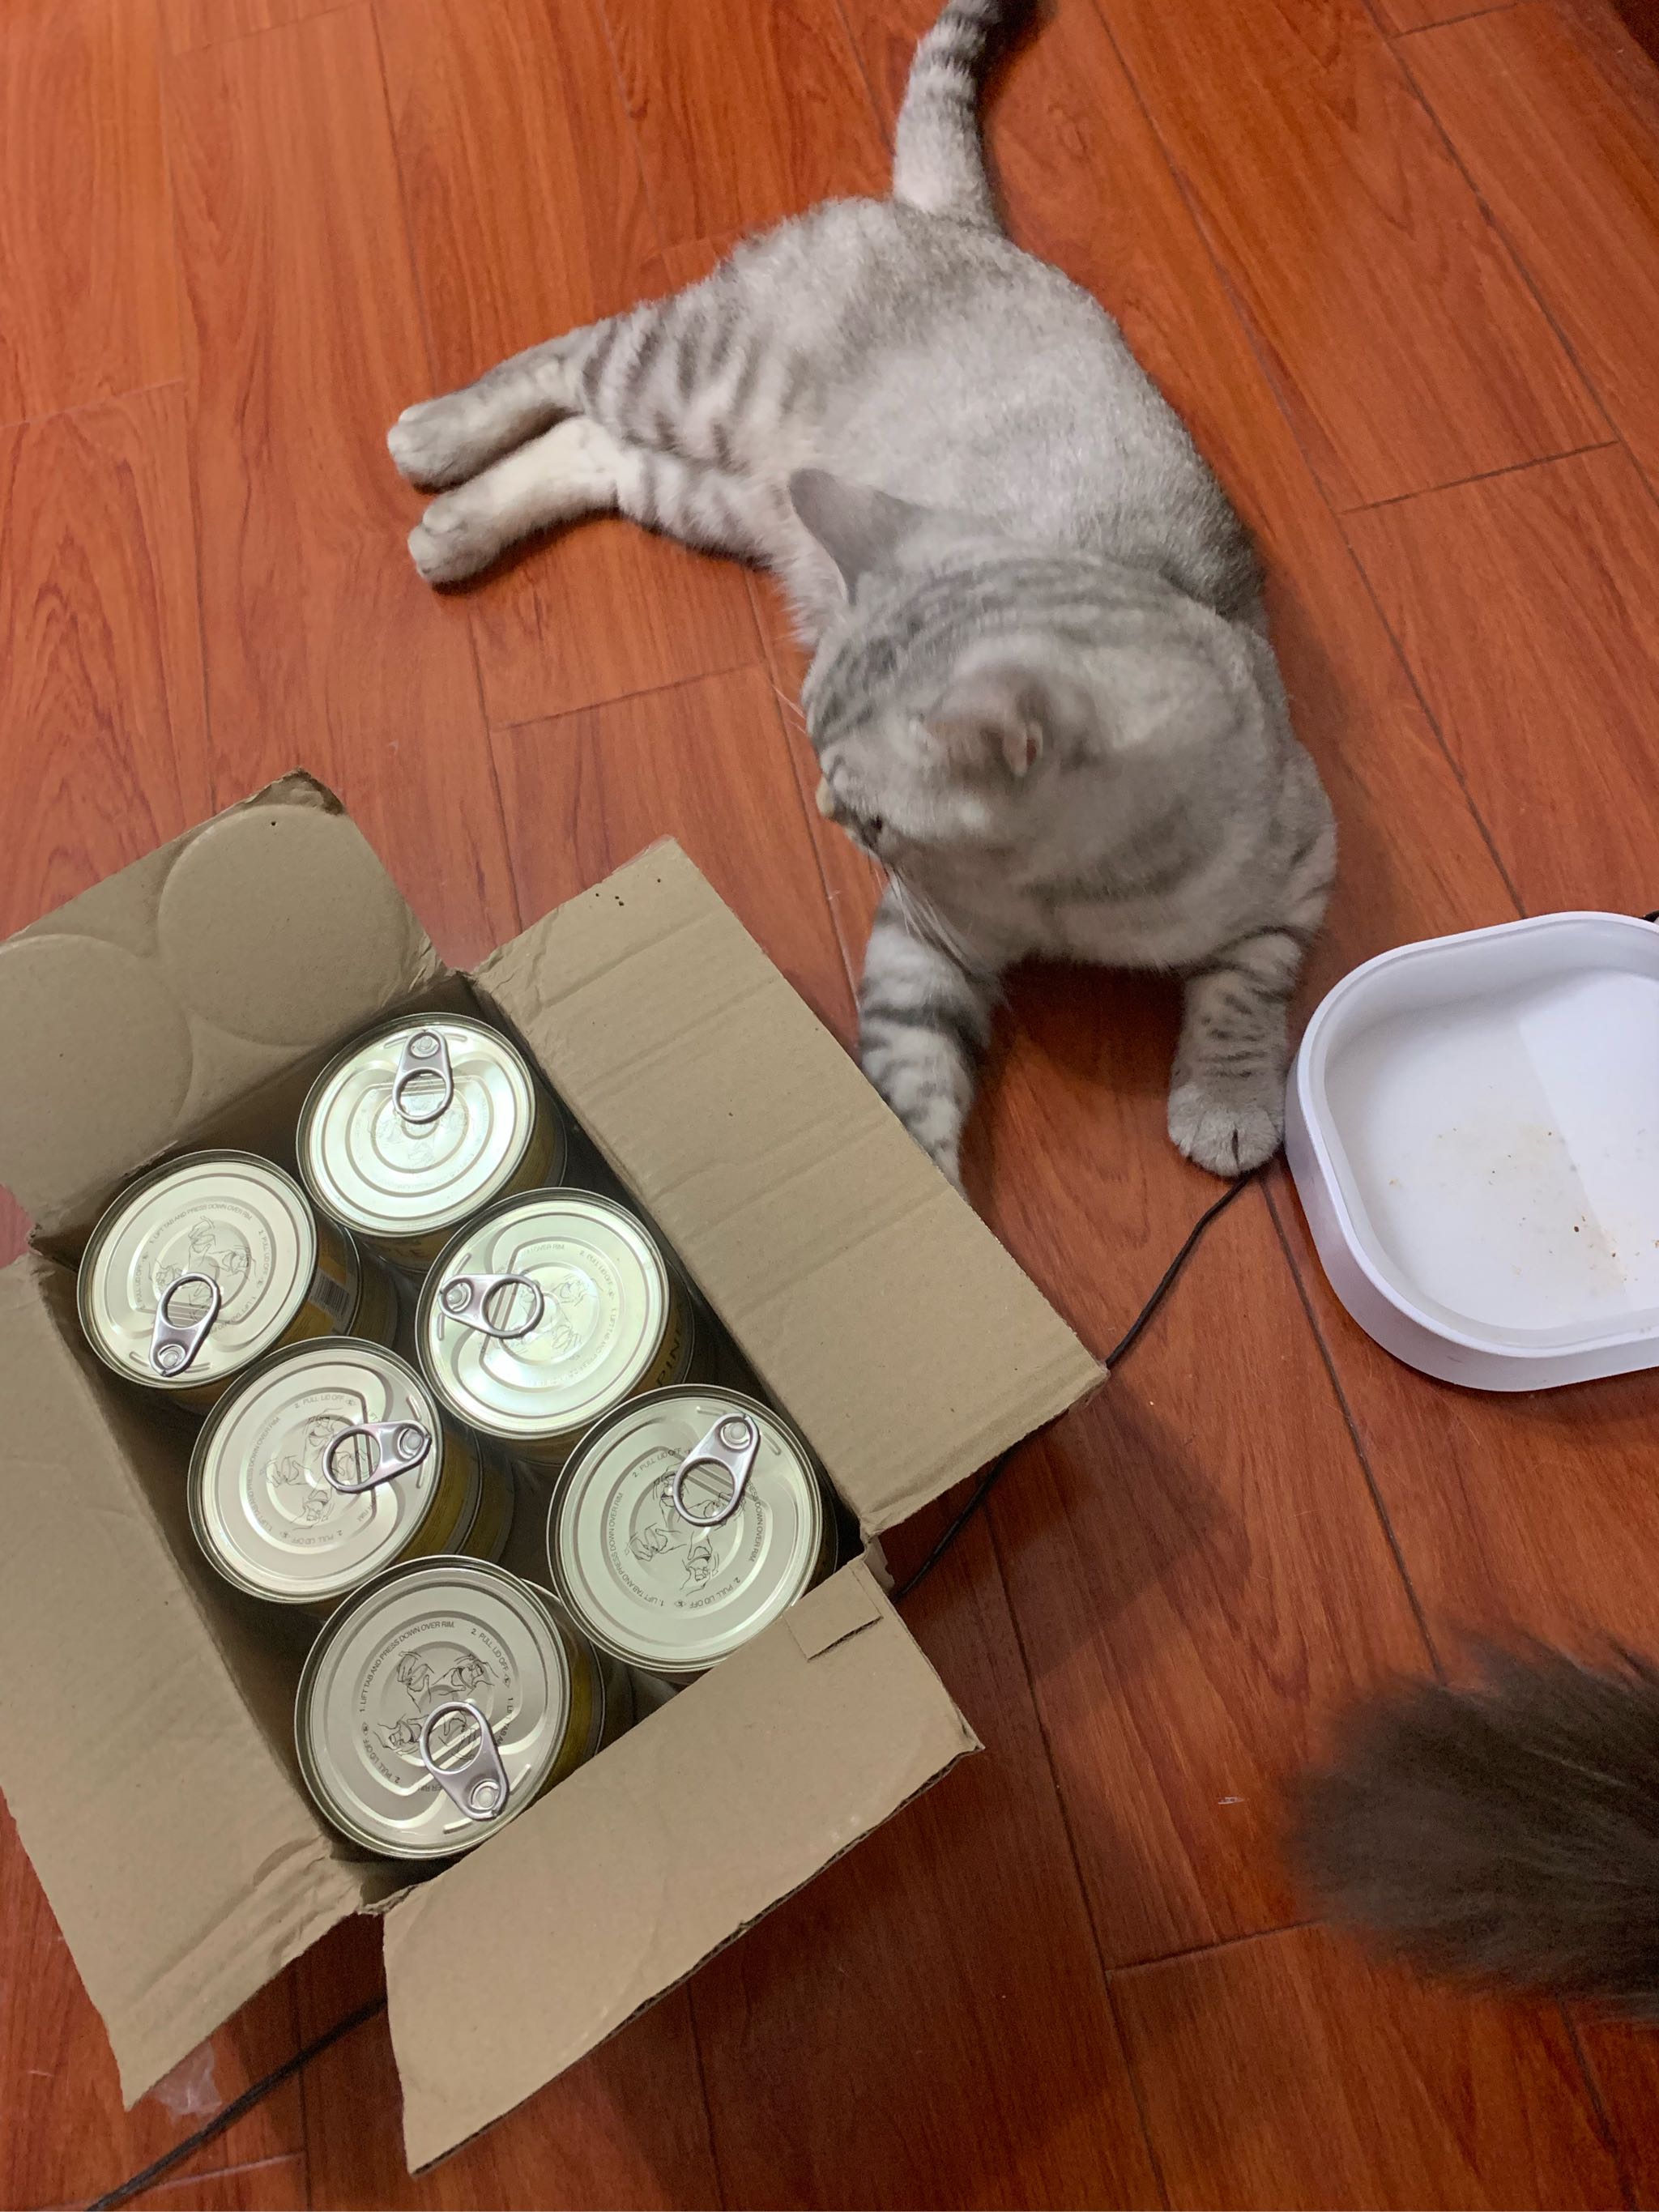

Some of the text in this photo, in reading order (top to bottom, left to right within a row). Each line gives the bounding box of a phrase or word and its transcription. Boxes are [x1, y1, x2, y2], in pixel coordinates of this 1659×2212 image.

[227, 1204, 242, 1215] OVER
[302, 1396, 319, 1405] PULL
[639, 1459, 656, 1471] PULL
[656, 1451, 668, 1460] LID
[667, 1447, 681, 1456] OFF
[608, 1507, 618, 1528] OVER
[754, 1502, 763, 1526] DOWN
[608, 1528, 617, 1552] DOWN
[755, 1526, 764, 1547] OVER
[612, 1551, 625, 1575] PRESS
[622, 1574, 636, 1588] AND
[633, 1586, 645, 1597] TAB
[715, 1585, 734, 1599] PULL
[643, 1594, 659, 1605] LIFT
[689, 1600, 704, 1609] OFF
[704, 1595, 716, 1605] LID
[420, 1621, 441, 1631] OVER
[399, 1626, 420, 1643] DOWN
[379, 1639, 400, 1660] PRESS
[478, 1632, 493, 1649] PULL
[492, 1647, 501, 1659] LID
[498, 1656, 510, 1672] OFF
[370, 1659, 382, 1675] AND
[363, 1676, 373, 1688] TAB
[360, 1689, 369, 1705] LIFT
[362, 1738, 373, 1753] OFF
[369, 1751, 380, 1764] LID
[378, 1762, 394, 1779] PULL
